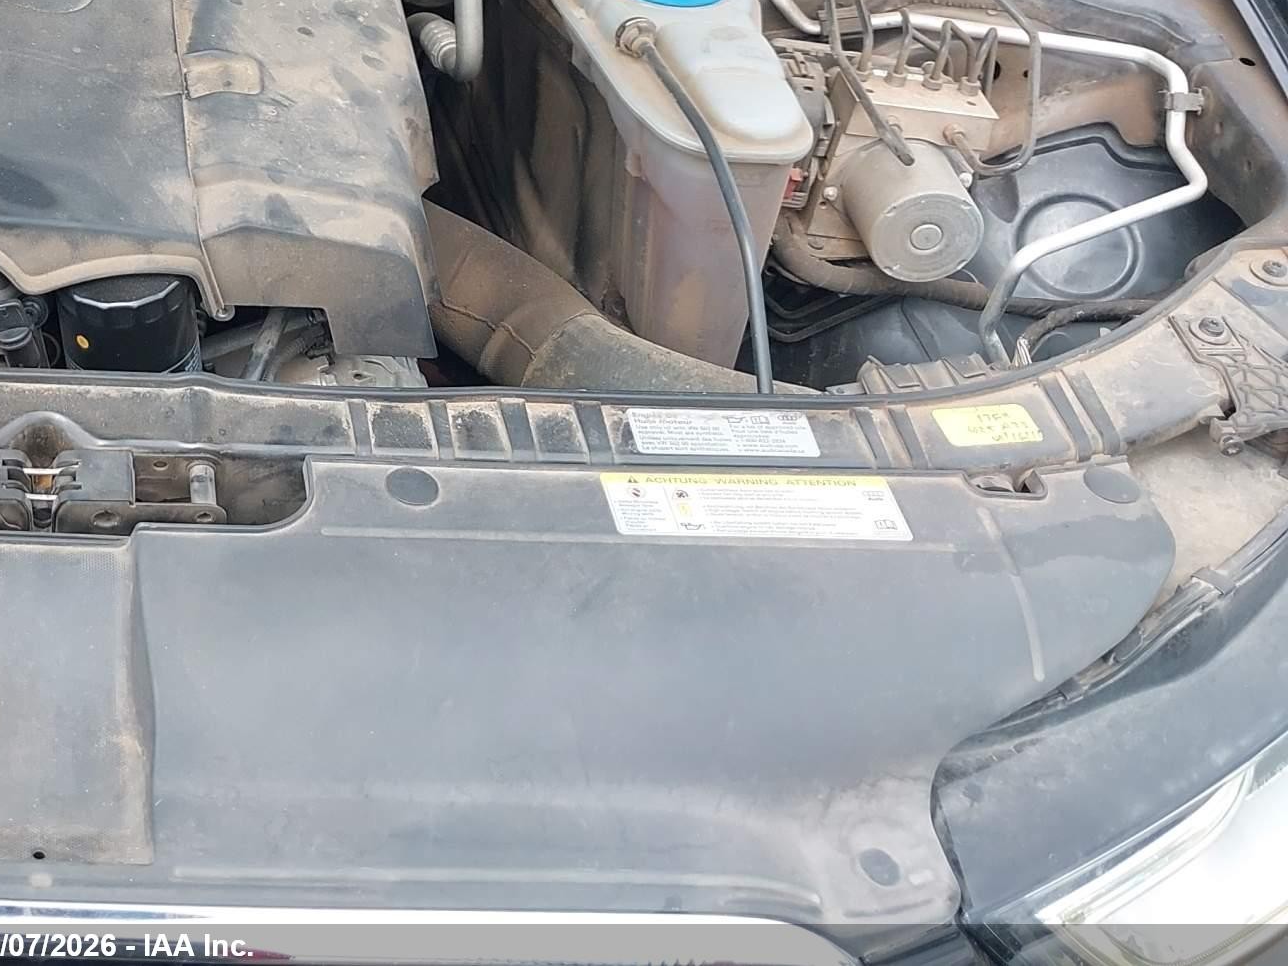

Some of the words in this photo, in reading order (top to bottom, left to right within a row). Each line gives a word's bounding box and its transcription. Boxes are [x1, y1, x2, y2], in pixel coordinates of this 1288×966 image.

[645, 475, 708, 484] ACHTUNG
[714, 477, 779, 485] WARNING
[786, 478, 857, 487] ATTENTION
